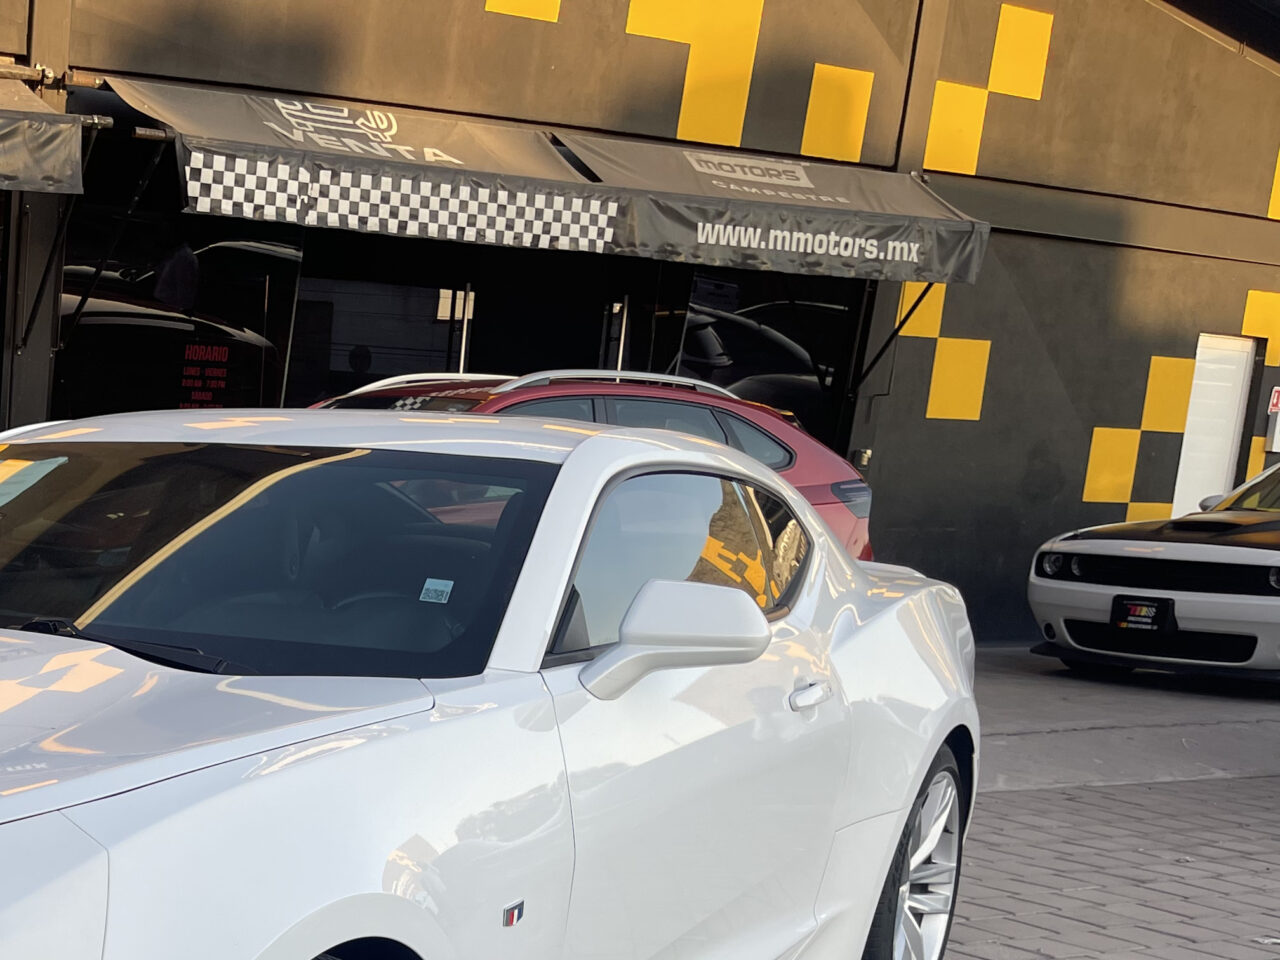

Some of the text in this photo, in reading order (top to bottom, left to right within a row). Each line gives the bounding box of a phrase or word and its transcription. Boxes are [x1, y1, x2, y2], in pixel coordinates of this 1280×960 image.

[263, 121, 464, 165] VENTA
[696, 158, 801, 182] MOTORS
[711, 179, 850, 204] CAMPESTRE
[696, 221, 921, 263] www.mmotors.mx
[184, 344, 229, 362] HORARIO
